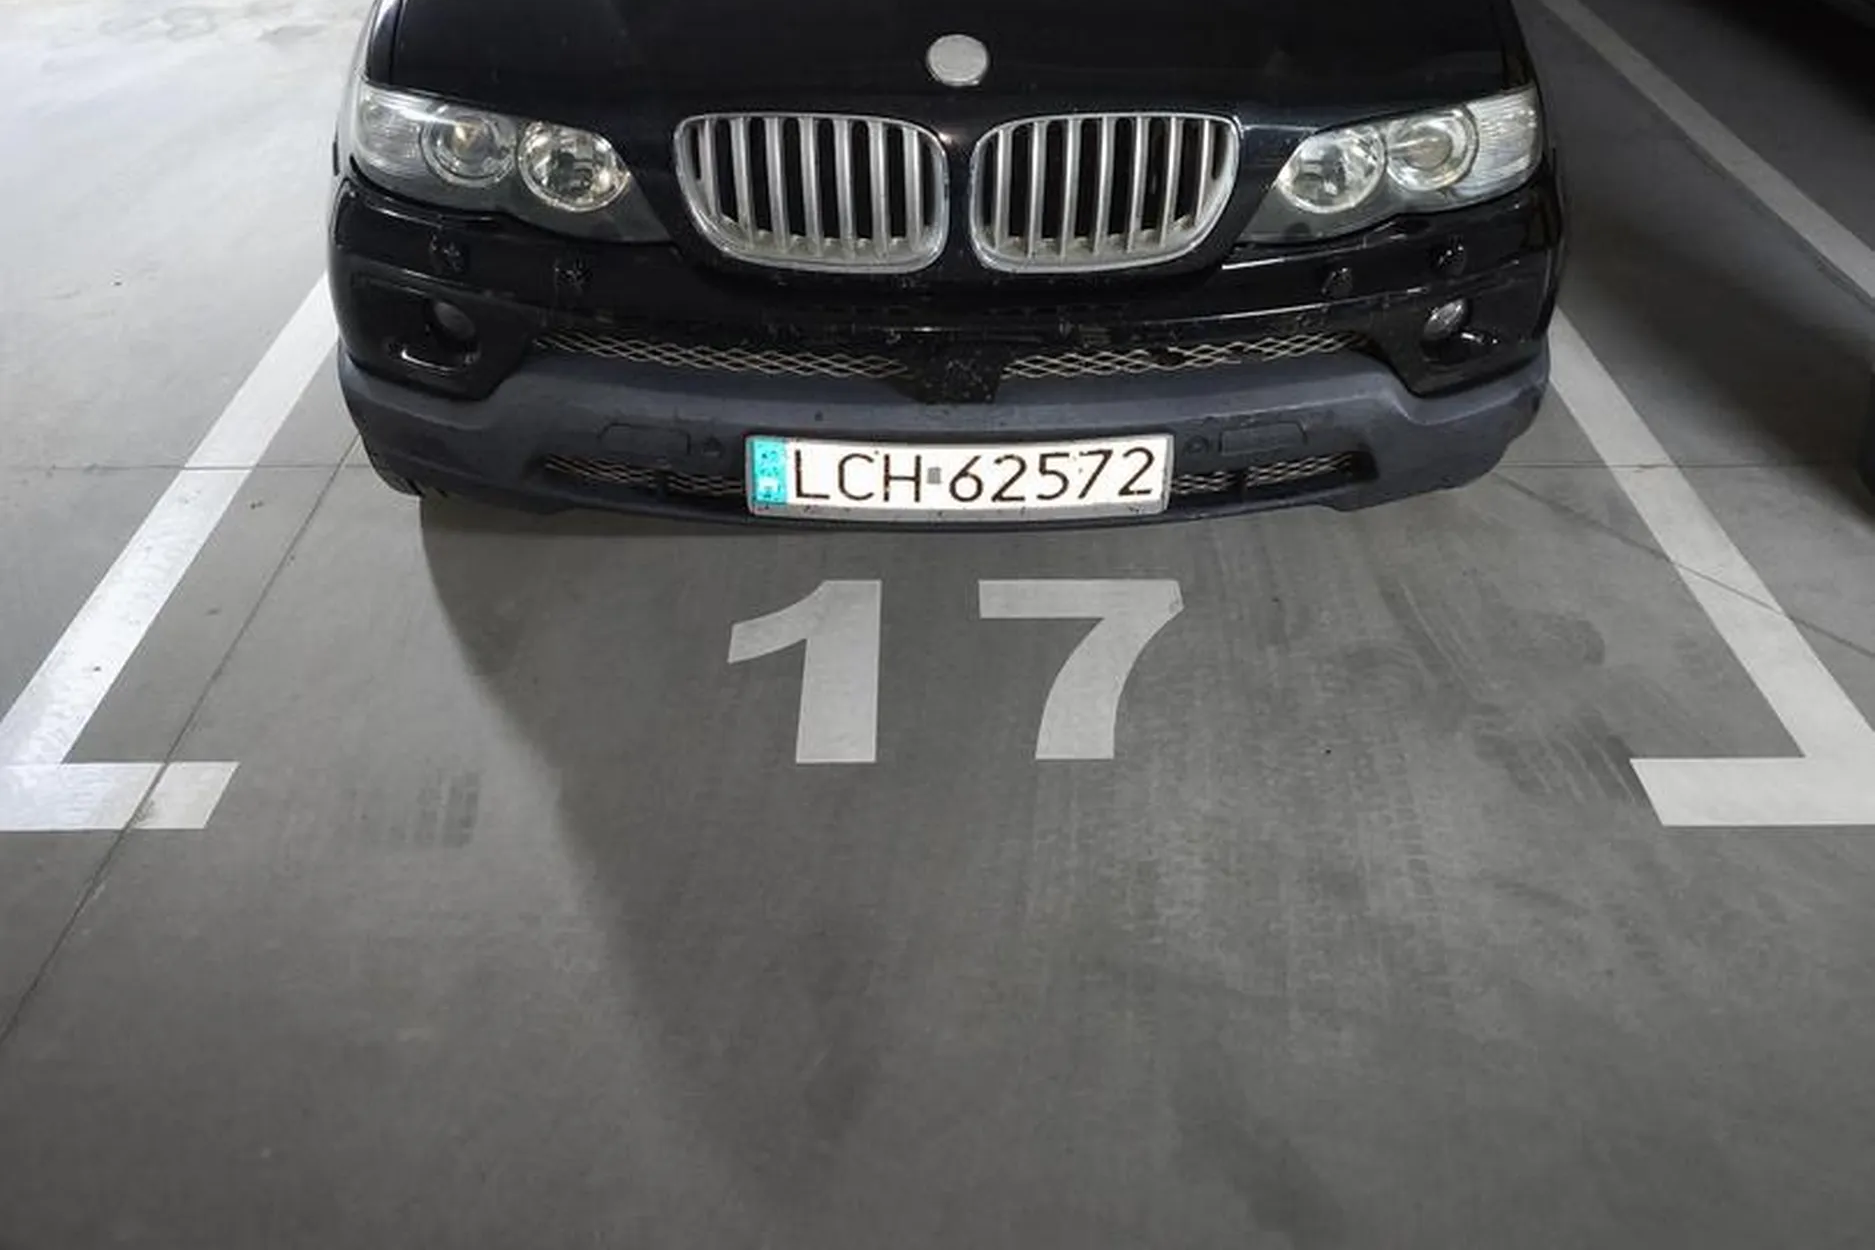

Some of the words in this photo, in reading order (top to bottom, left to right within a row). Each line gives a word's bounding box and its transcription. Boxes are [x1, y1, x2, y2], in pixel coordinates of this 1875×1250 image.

[794, 449, 922, 503] LCH
[948, 446, 1156, 503] 62572
[727, 579, 1185, 764] 17
